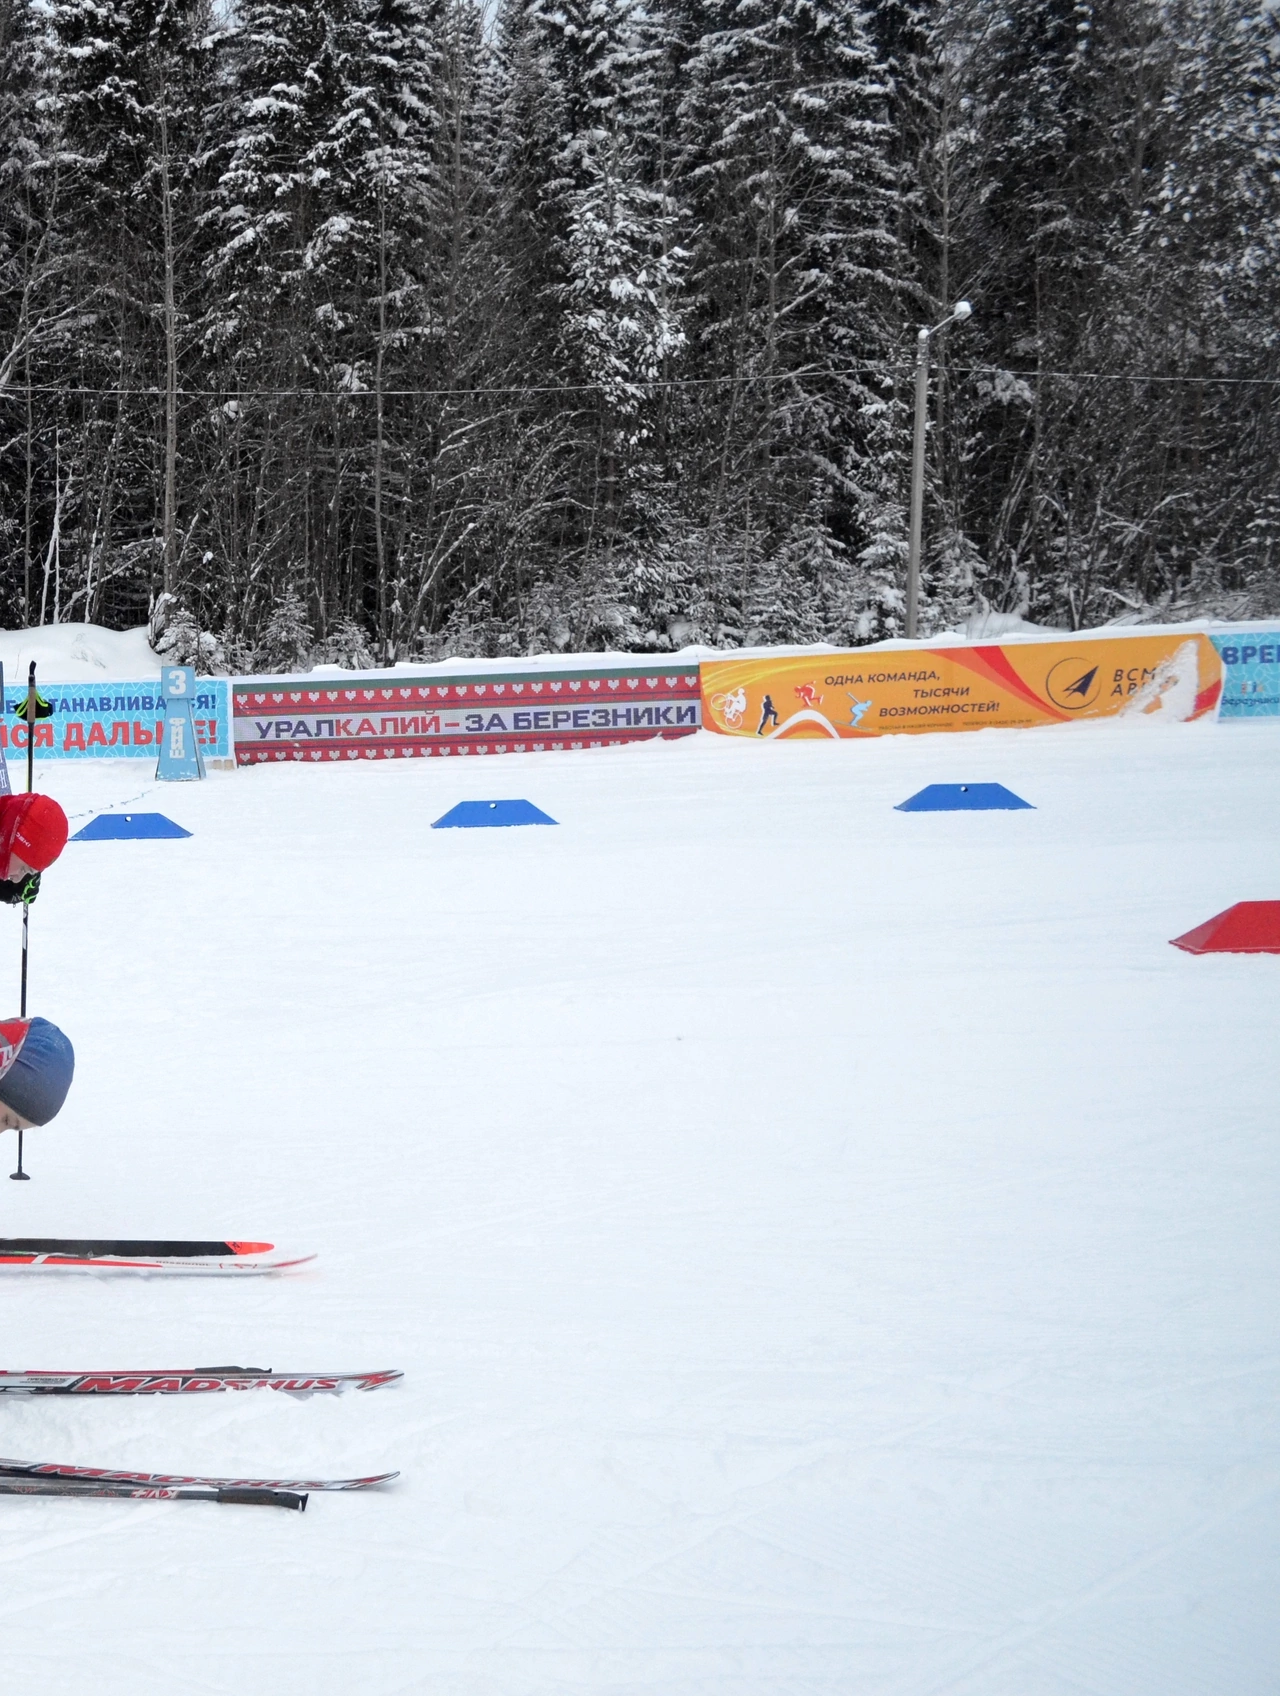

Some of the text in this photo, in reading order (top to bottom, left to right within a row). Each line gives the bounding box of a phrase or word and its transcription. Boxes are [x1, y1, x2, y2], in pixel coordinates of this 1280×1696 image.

[1222, 645, 1280, 665] ВРЕ
[168, 670, 186, 695] 3
[824, 671, 940, 686] ОДНА КОМАНДА,
[913, 686, 970, 698] ТЫСЯЧИ
[879, 701, 1000, 717] ВОЗМОЖНОСТЕЙ!
[255, 710, 440, 739] УРАЛКАЛИЙ
[465, 713, 508, 732] ЗА
[513, 705, 697, 730] БЕРЕЗНИКИ
